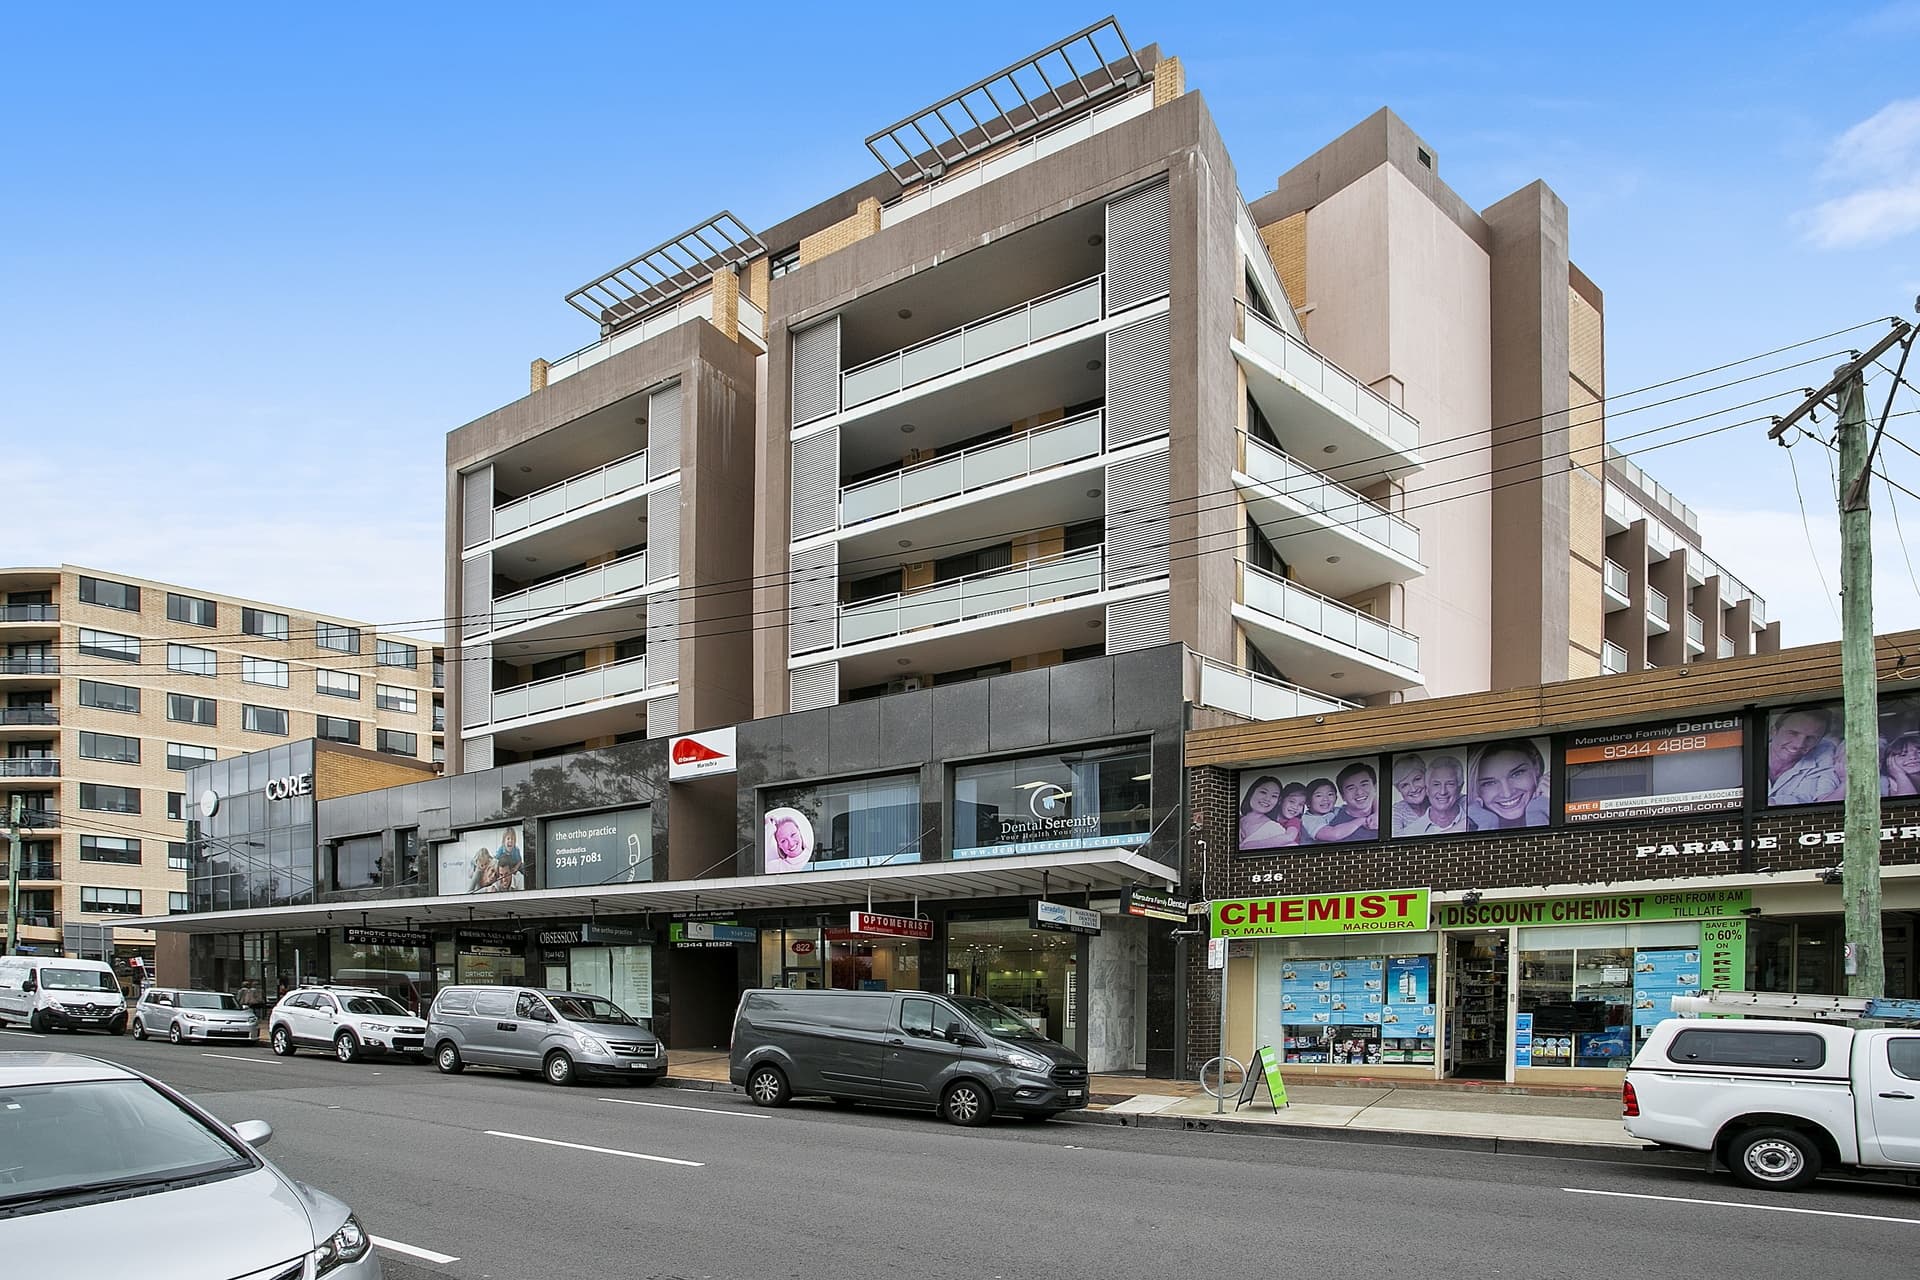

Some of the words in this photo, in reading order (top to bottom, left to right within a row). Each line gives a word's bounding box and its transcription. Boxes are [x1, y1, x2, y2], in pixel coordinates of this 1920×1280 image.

[1575, 733, 1633, 745] Maroubra
[1635, 727, 1673, 740] Family
[1676, 717, 1739, 734] Dental
[1604, 743, 1650, 759] 9344
[1657, 736, 1707, 752] 4888
[265, 772, 311, 801] CORE
[1568, 803, 1591, 811] SUITE
[1571, 801, 1741, 821] maroubrafamilydental.com.au
[1001, 818, 1042, 834] Dental
[1045, 815, 1100, 831] Serenity
[555, 831, 567, 841] the
[568, 829, 587, 840] ortho
[588, 825, 617, 839] practice
[960, 835, 1143, 857] www.dentalserenity.com.au
[555, 855, 578, 868] 9344
[580, 852, 602, 866] 7081
[1251, 873, 1284, 883] 826
[1654, 894, 1682, 905] OPEN
[1686, 892, 1716, 903] FROM
[1719, 892, 1725, 902] 8
[1727, 891, 1743, 901] AM
[1220, 894, 1418, 924] CHEMIST
[1447, 902, 1546, 925] DISCOUNT
[1551, 897, 1645, 921] CHEMIST
[1673, 907, 1694, 917] TILL
[1697, 905, 1723, 916] LATE
[863, 915, 929, 931] OPTOMETRIST
[1221, 928, 1240, 936] BY
[1243, 925, 1277, 936] MAIL
[1343, 921, 1415, 931] MAROUBRA
[539, 930, 579, 944] OBSESSION
[1705, 932, 1715, 941] to
[1717, 929, 1742, 940] 60%
[795, 943, 811, 952] 822
